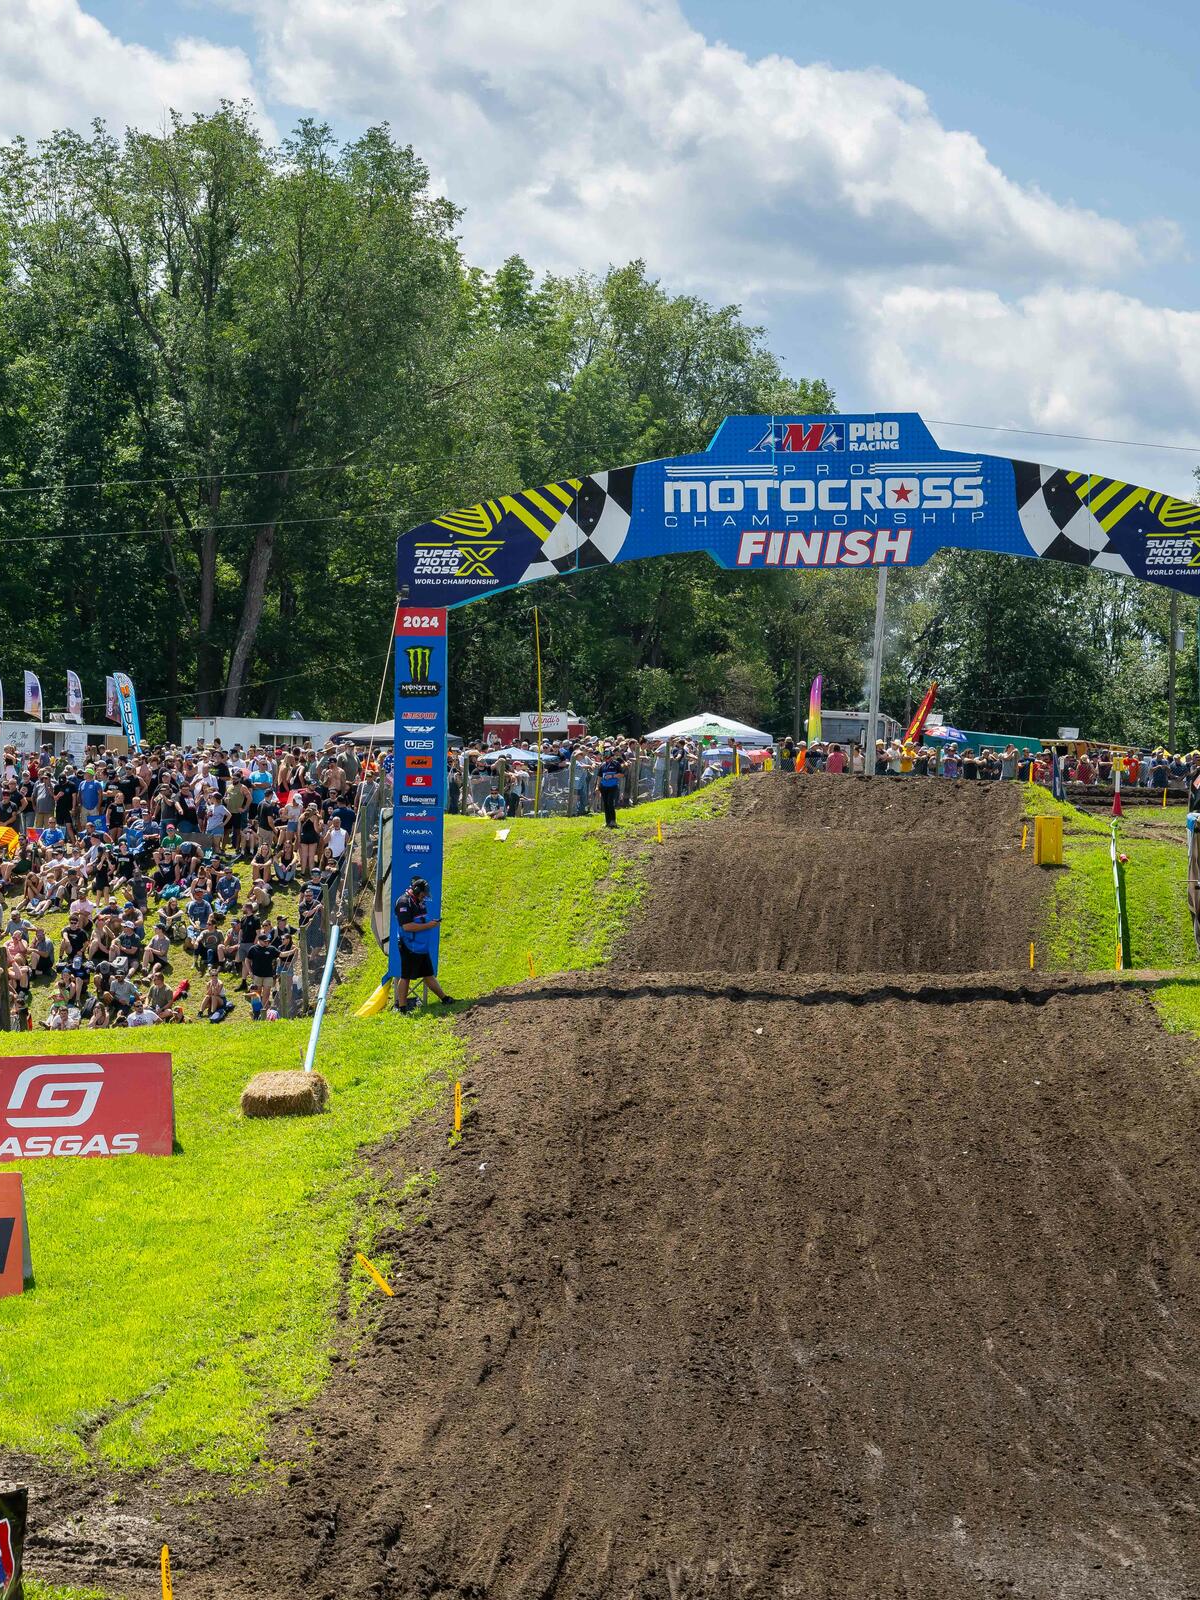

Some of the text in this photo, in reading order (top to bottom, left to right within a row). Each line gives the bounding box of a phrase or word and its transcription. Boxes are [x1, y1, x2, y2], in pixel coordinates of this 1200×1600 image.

[849, 421, 900, 441] PRO
[849, 440, 900, 452] RACING
[783, 464, 864, 476] PRO
[664, 477, 984, 513] MOTOCROSS
[664, 512, 984, 528] CHAMPIONSHIP
[736, 529, 913, 566] FINISH
[1146, 539, 1194, 548] SUPER
[414, 549, 463, 558] SUPER
[1148, 548, 1192, 557] MOTO
[416, 558, 460, 566] MOTO
[1145, 556, 1193, 565] CROSS
[413, 566, 461, 574] CROSS
[403, 615, 439, 628] 2024
[404, 740, 435, 750] WPS
